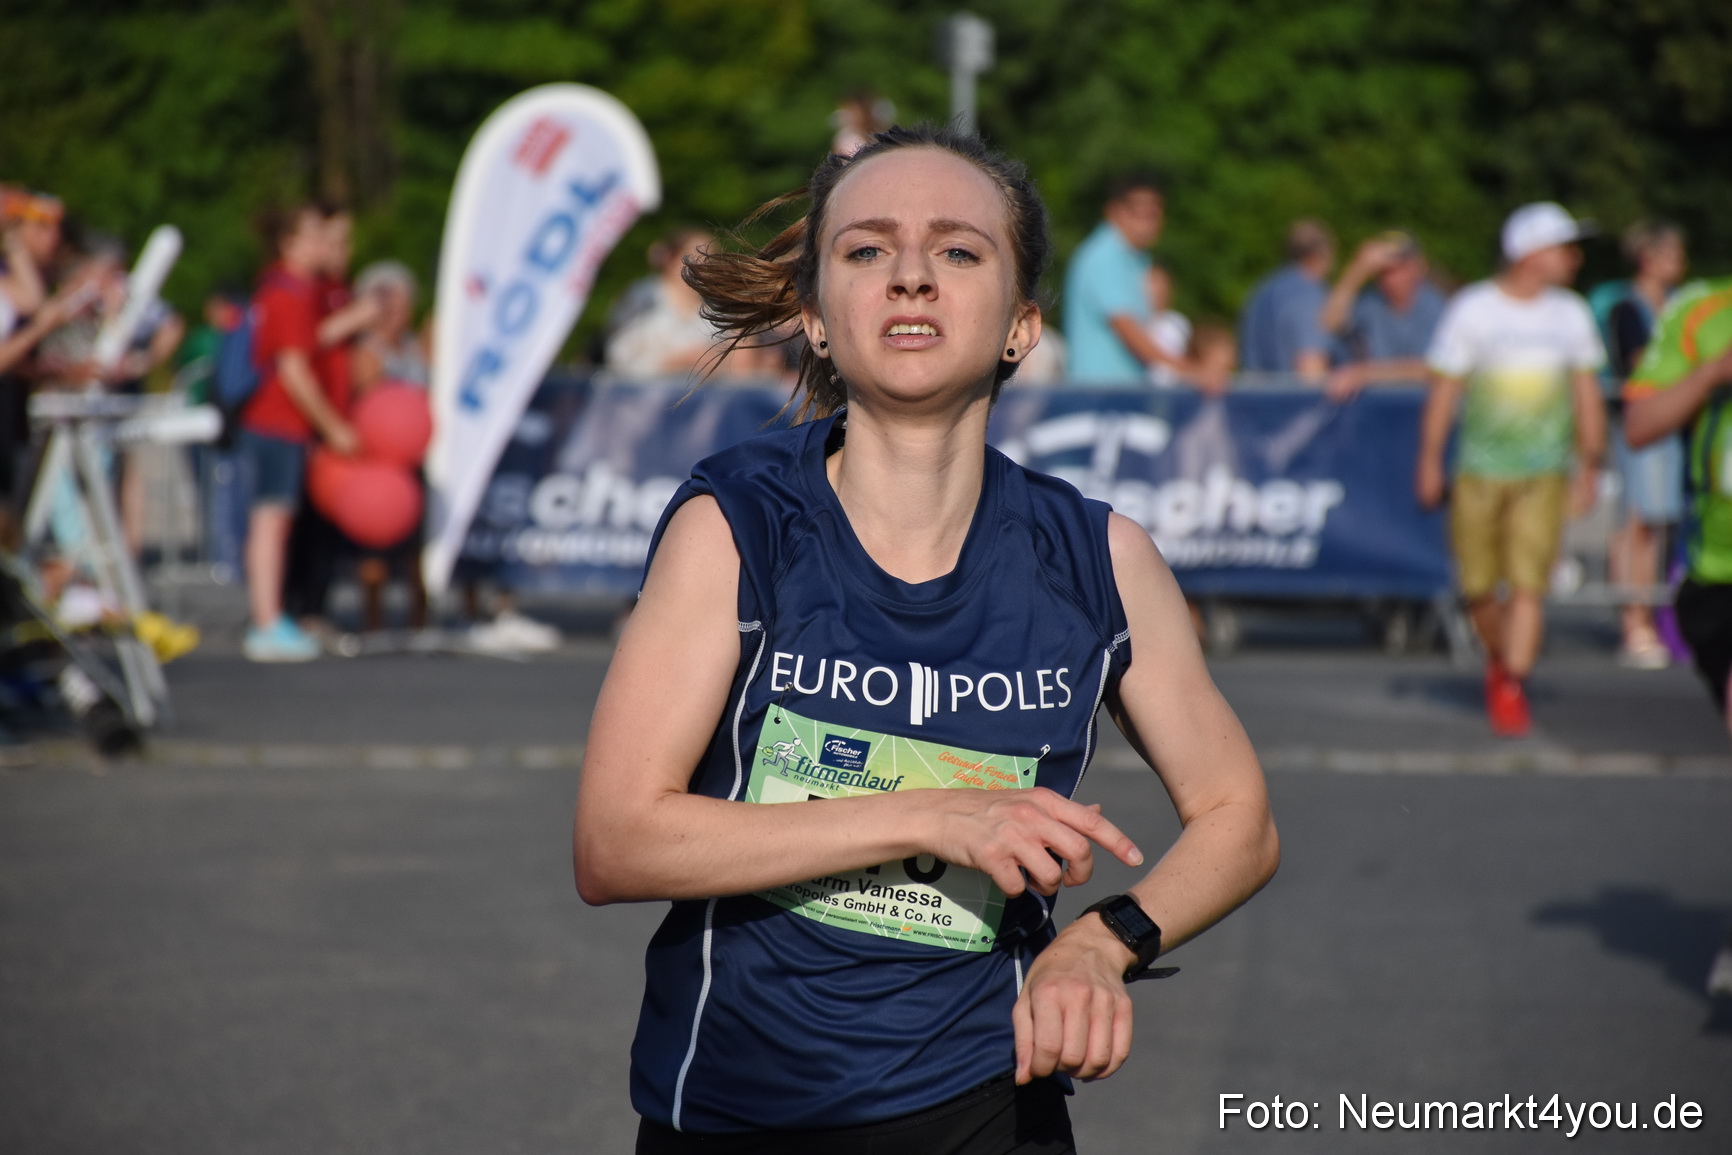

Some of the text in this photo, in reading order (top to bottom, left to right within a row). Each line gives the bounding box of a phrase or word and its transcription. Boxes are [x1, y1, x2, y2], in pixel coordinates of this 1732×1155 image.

[771, 652, 1071, 712] EURO POLES
[831, 744, 862, 756] Fischer
[795, 756, 904, 792] firmenlauf
[938, 751, 1019, 783] Gesunde Firmen
[953, 768, 984, 787] laufen
[793, 774, 840, 791] neumarkt
[858, 878, 943, 908] Vanessa
[843, 897, 886, 915] GmbH
[890, 906, 899, 918] &
[904, 908, 926, 923] Co.
[931, 913, 953, 927] KG
